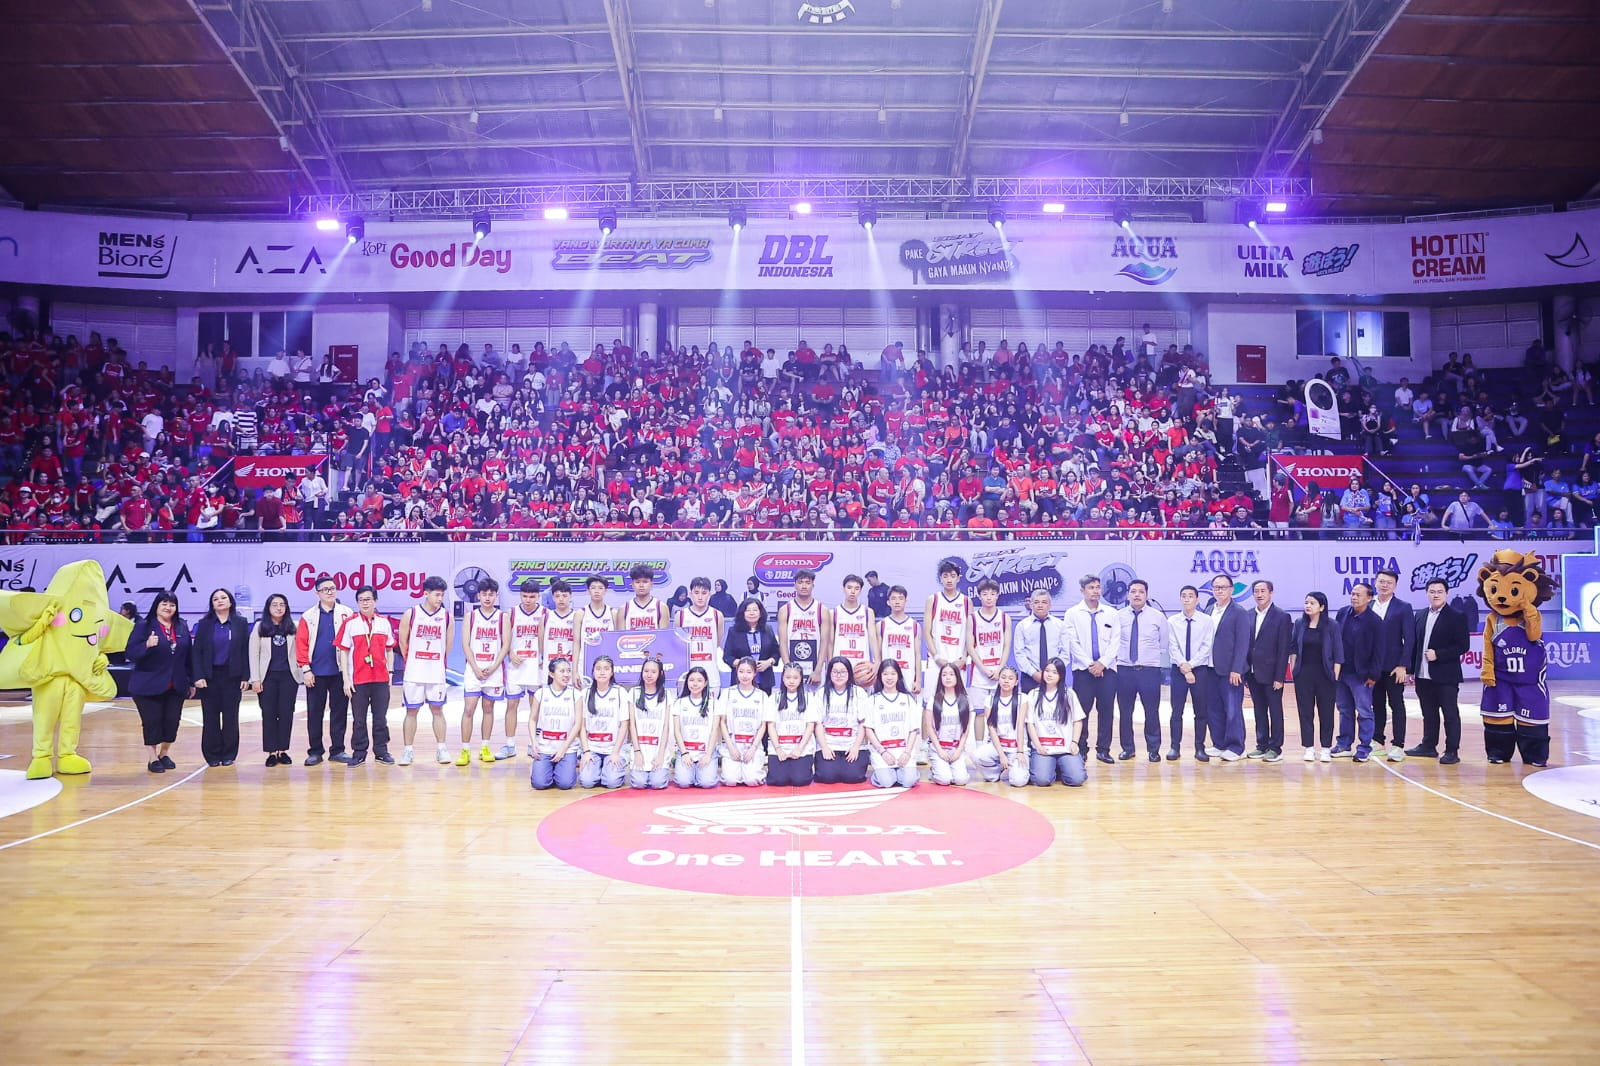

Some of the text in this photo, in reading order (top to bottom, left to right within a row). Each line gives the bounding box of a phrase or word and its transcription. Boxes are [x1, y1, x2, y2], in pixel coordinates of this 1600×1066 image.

[758, 235, 832, 265] DBL
[1111, 235, 1179, 262] AQUA
[1411, 234, 1459, 257] HOT
[98, 246, 164, 269] Bioré
[390, 241, 512, 275] Good Day
[905, 248, 924, 261] PAKE
[1237, 244, 1294, 261] ULTRA
[758, 266, 834, 278] INDONESIA
[928, 266, 949, 279] GAYA
[950, 263, 977, 277] MAKIN
[1244, 262, 1289, 278] MILK
[1412, 255, 1486, 278] CREAM
[1295, 467, 1363, 477] HONDA
[511, 560, 545, 571] YANG
[546, 560, 592, 571] WORTH
[612, 560, 630, 571] YA
[1190, 550, 1260, 578] AQUA
[1334, 556, 1402, 575] ULTRA
[371, 563, 426, 598] Day
[774, 570, 794, 580] DBL
[998, 580, 1019, 595] AKIN
[776, 590, 797, 599] Good
[630, 616, 656, 627] FINAL
[793, 618, 816, 629] FINAL
[416, 624, 442, 635] FINAL
[548, 627, 574, 638] FINAL
[691, 626, 713, 636] INAL
[838, 623, 865, 634] FINAL
[945, 625, 952, 636] 5
[848, 639, 857, 650] 10
[887, 633, 911, 645] FINAL
[482, 643, 490, 653] 12
[989, 647, 995, 657] 4
[1503, 646, 1528, 656] GLORIA
[1545, 641, 1592, 668] QUA
[1506, 657, 1526, 673] 01
[1520, 708, 1531, 719] 01
[642, 824, 948, 836] HONDA
[627, 848, 965, 867] One HEART.
